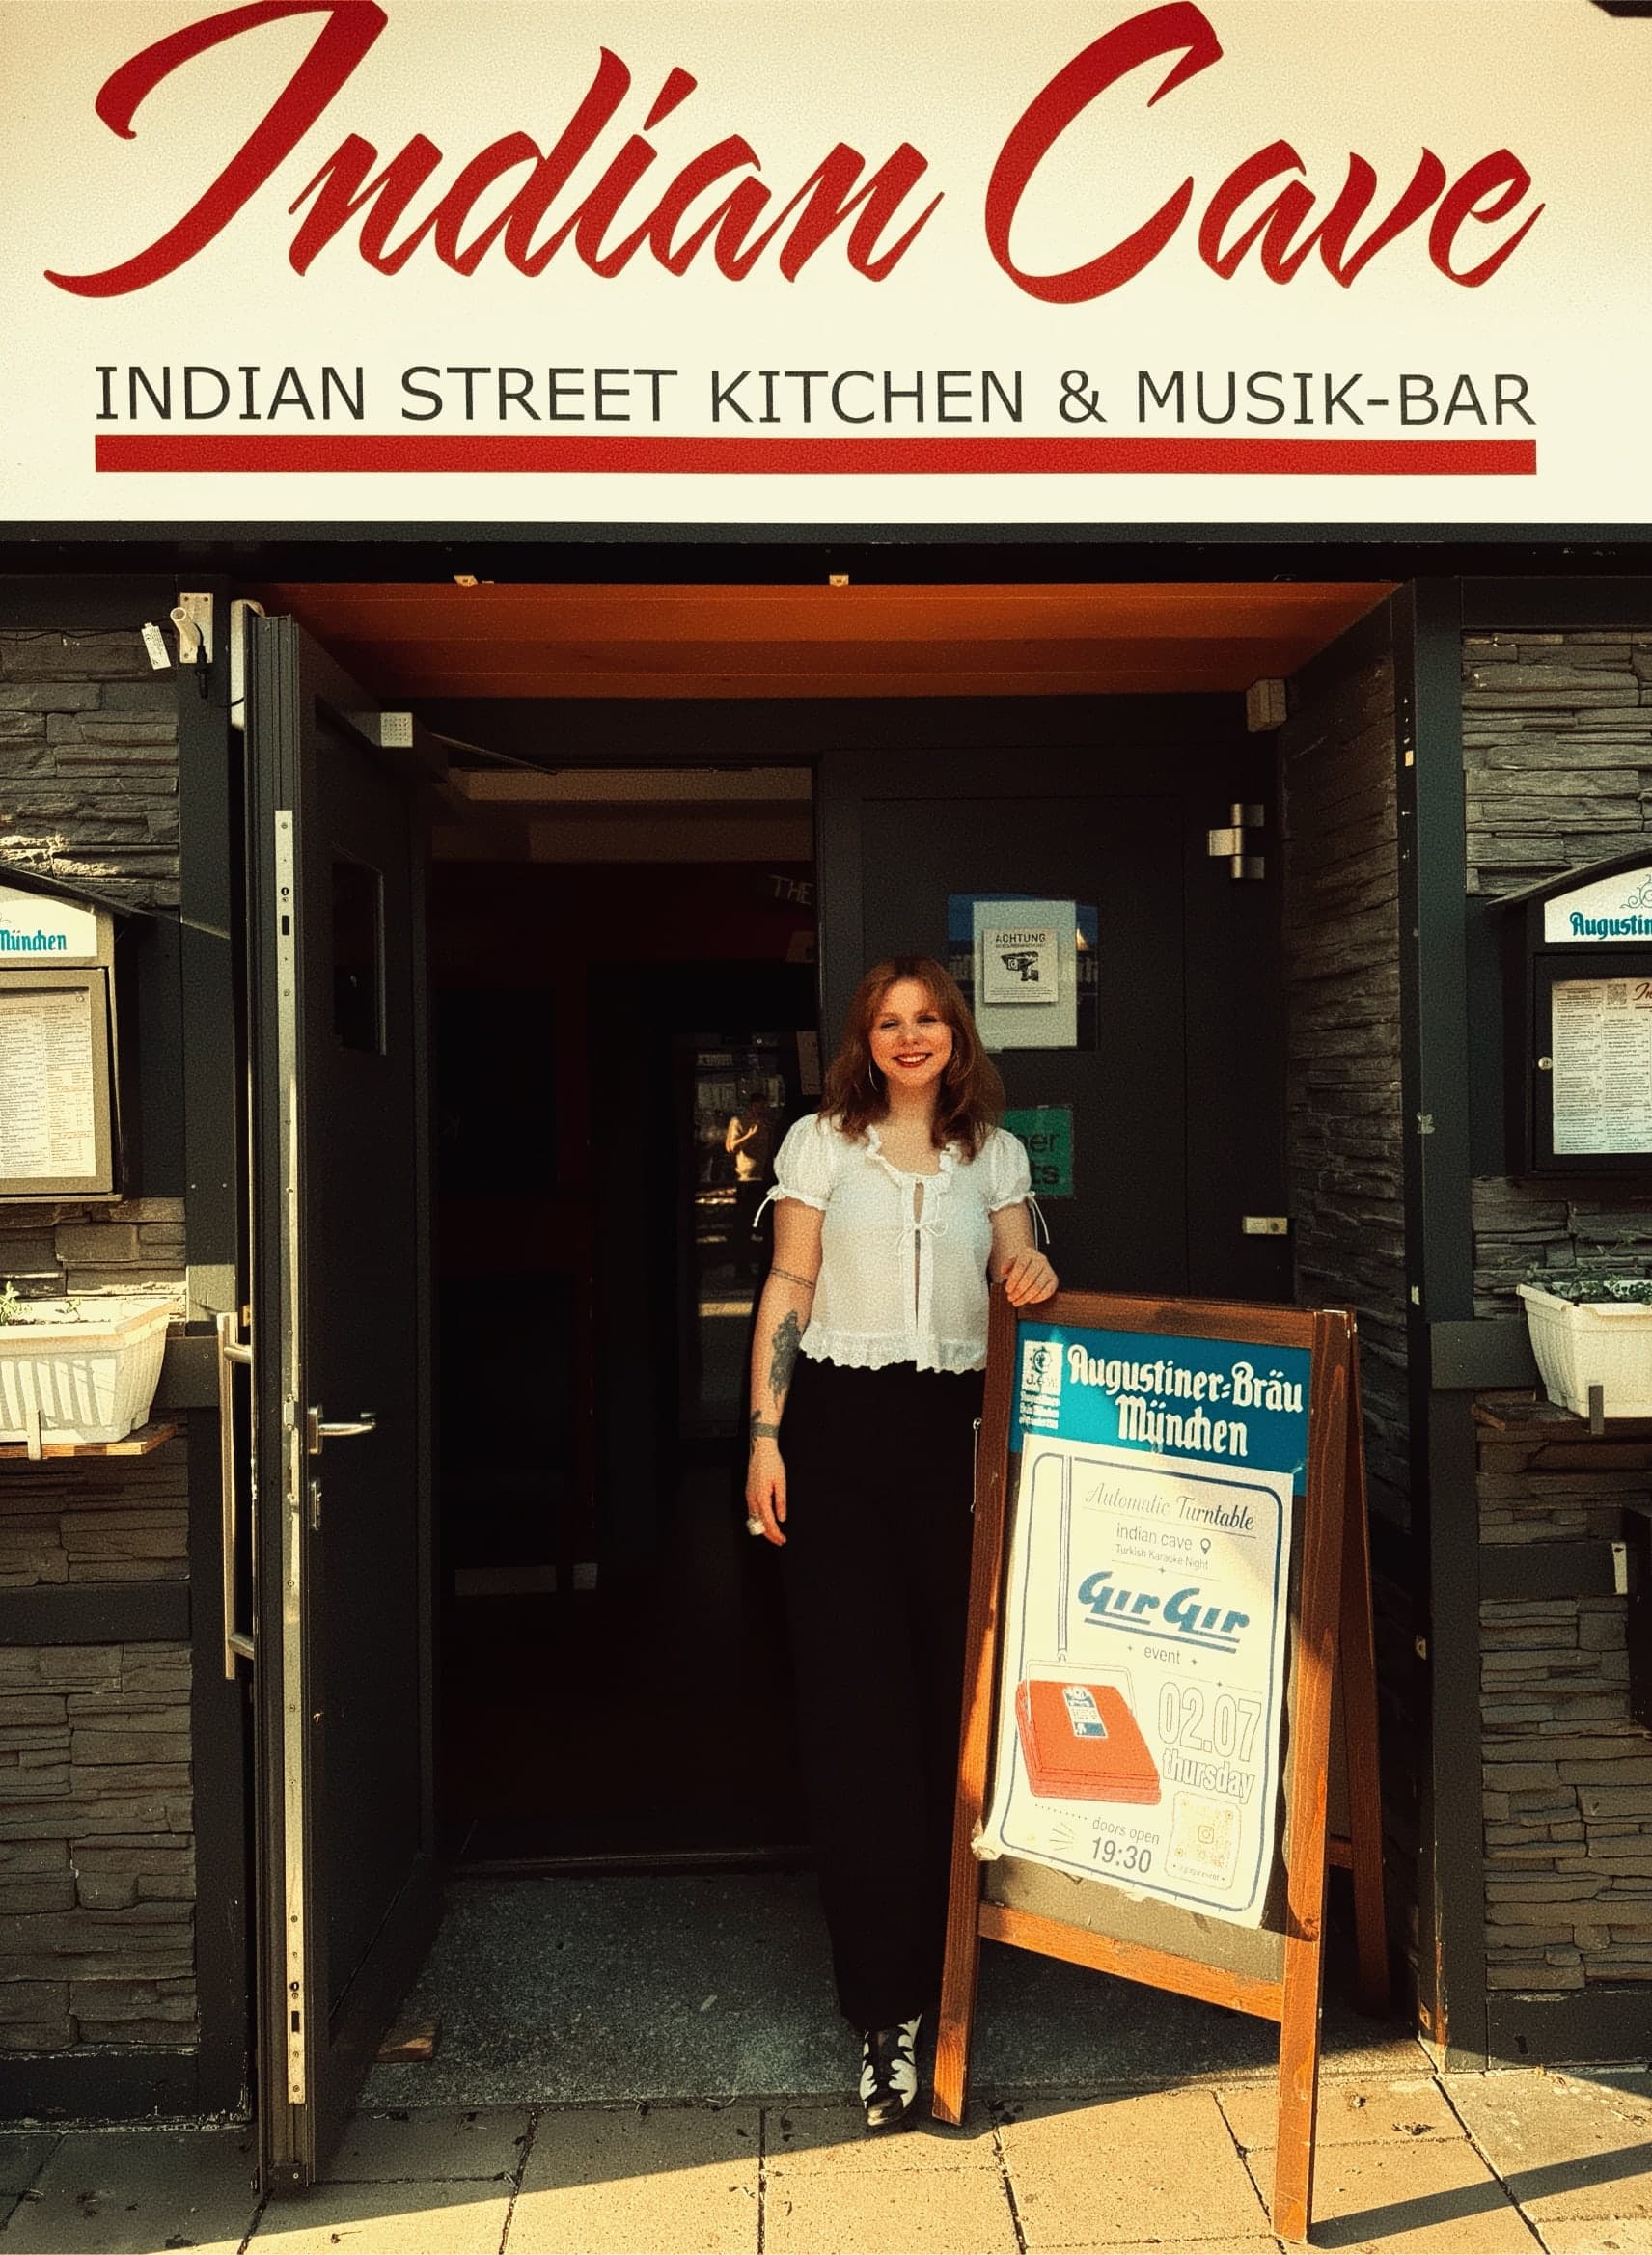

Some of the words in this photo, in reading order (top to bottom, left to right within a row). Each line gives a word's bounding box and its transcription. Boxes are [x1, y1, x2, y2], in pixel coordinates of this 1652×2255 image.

[45, 0, 944, 297] Indian
[984, 1, 1546, 304] Cave
[96, 366, 366, 420] INDIAN
[401, 366, 678, 422] STREET
[711, 369, 1024, 423] KITCHEN
[1059, 369, 1107, 424] &
[1138, 371, 1537, 426] MUSIK-BAR
[995, 933, 1047, 944] ACHTUNG
[1115, 1393, 1249, 1458] München
[1085, 1482, 1171, 1517] Automatic
[1175, 1495, 1255, 1531] Turntable
[1115, 1543, 1147, 1558] Turkish
[1185, 1555, 1209, 1571] Night
[1116, 1522, 1158, 1545] indian
[1161, 1533, 1193, 1551] cave
[1143, 1644, 1182, 1666] event
[1158, 1681, 1262, 1763] 02.07
[1161, 1747, 1256, 1805] thursday
[1091, 1815, 1126, 1837] doors
[1129, 1828, 1160, 1845] open
[1091, 1836, 1153, 1874] 19:30
